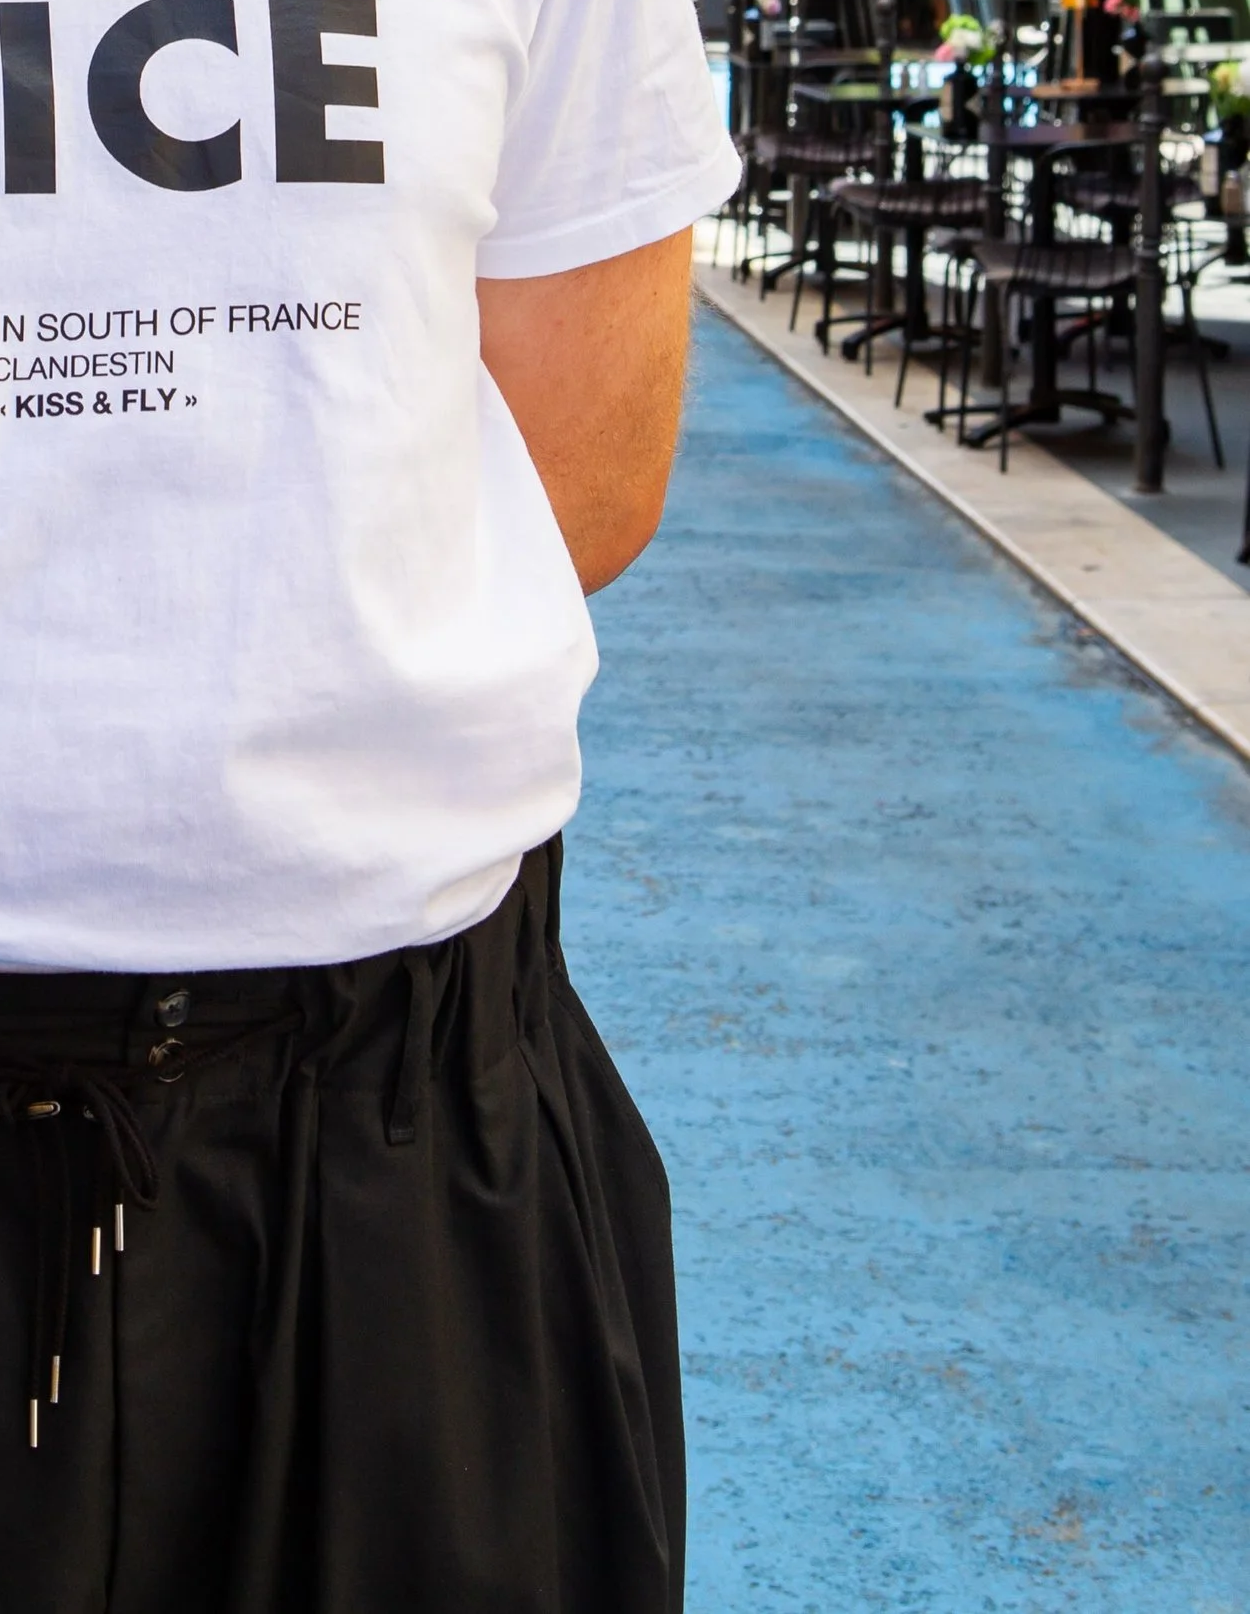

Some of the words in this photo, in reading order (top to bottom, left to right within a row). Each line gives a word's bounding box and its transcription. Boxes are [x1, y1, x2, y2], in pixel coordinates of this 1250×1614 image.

[37, 309, 158, 342] SOUTH
[170, 306, 217, 336] OF
[228, 302, 362, 333] FRANCE
[15, 391, 84, 419] KISS
[92, 391, 113, 415] &
[122, 387, 177, 413] FLY
